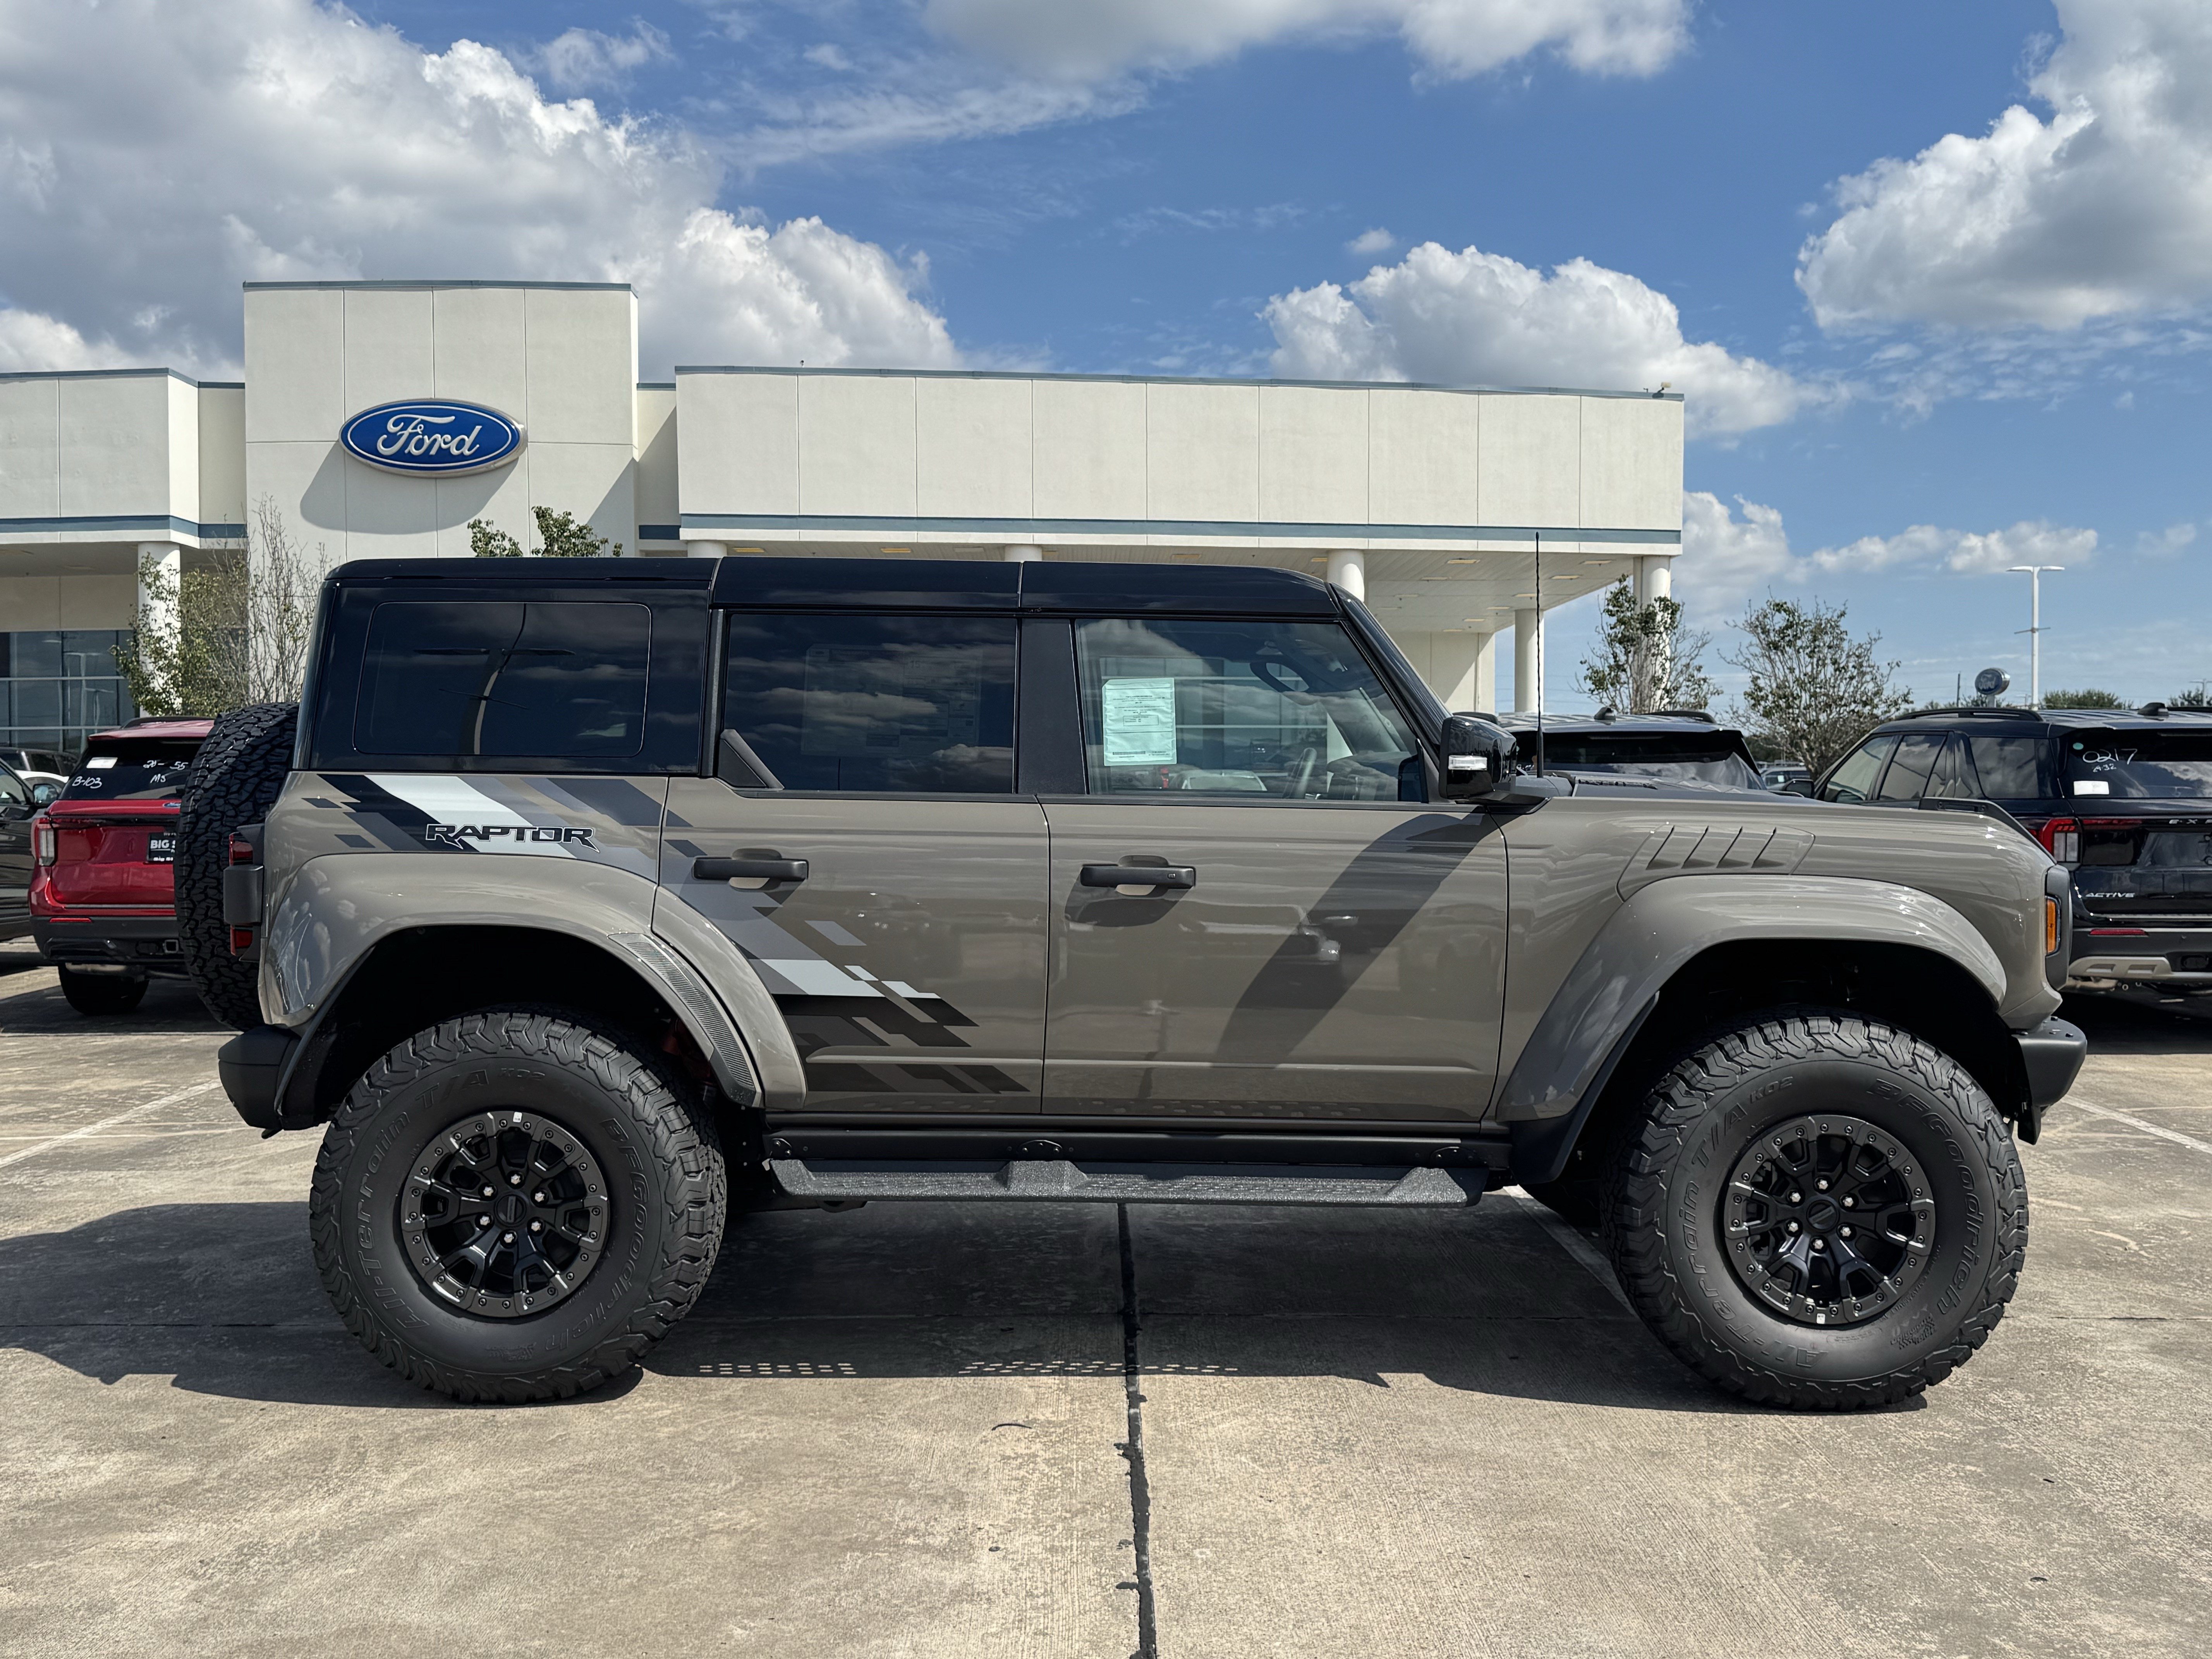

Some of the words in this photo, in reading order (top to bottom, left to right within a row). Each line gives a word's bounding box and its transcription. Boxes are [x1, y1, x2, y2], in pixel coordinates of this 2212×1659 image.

[376, 414, 483, 456] Ford
[2083, 748, 2138, 765] 0217
[72, 776, 102, 789] B-103
[150, 839, 170, 849] BIG
[425, 824, 600, 853] RAPTOR
[1750, 1076, 1794, 1104] KO2
[1691, 1103, 1748, 1168] T/A
[356, 1111, 431, 1333] All-Terrain
[414, 1069, 489, 1109] T/A
[1866, 1078, 1985, 1317] BFGoodrich
[544, 1117, 651, 1352] BFGoodrich
[1678, 1181, 1828, 1368] All-Terrain
